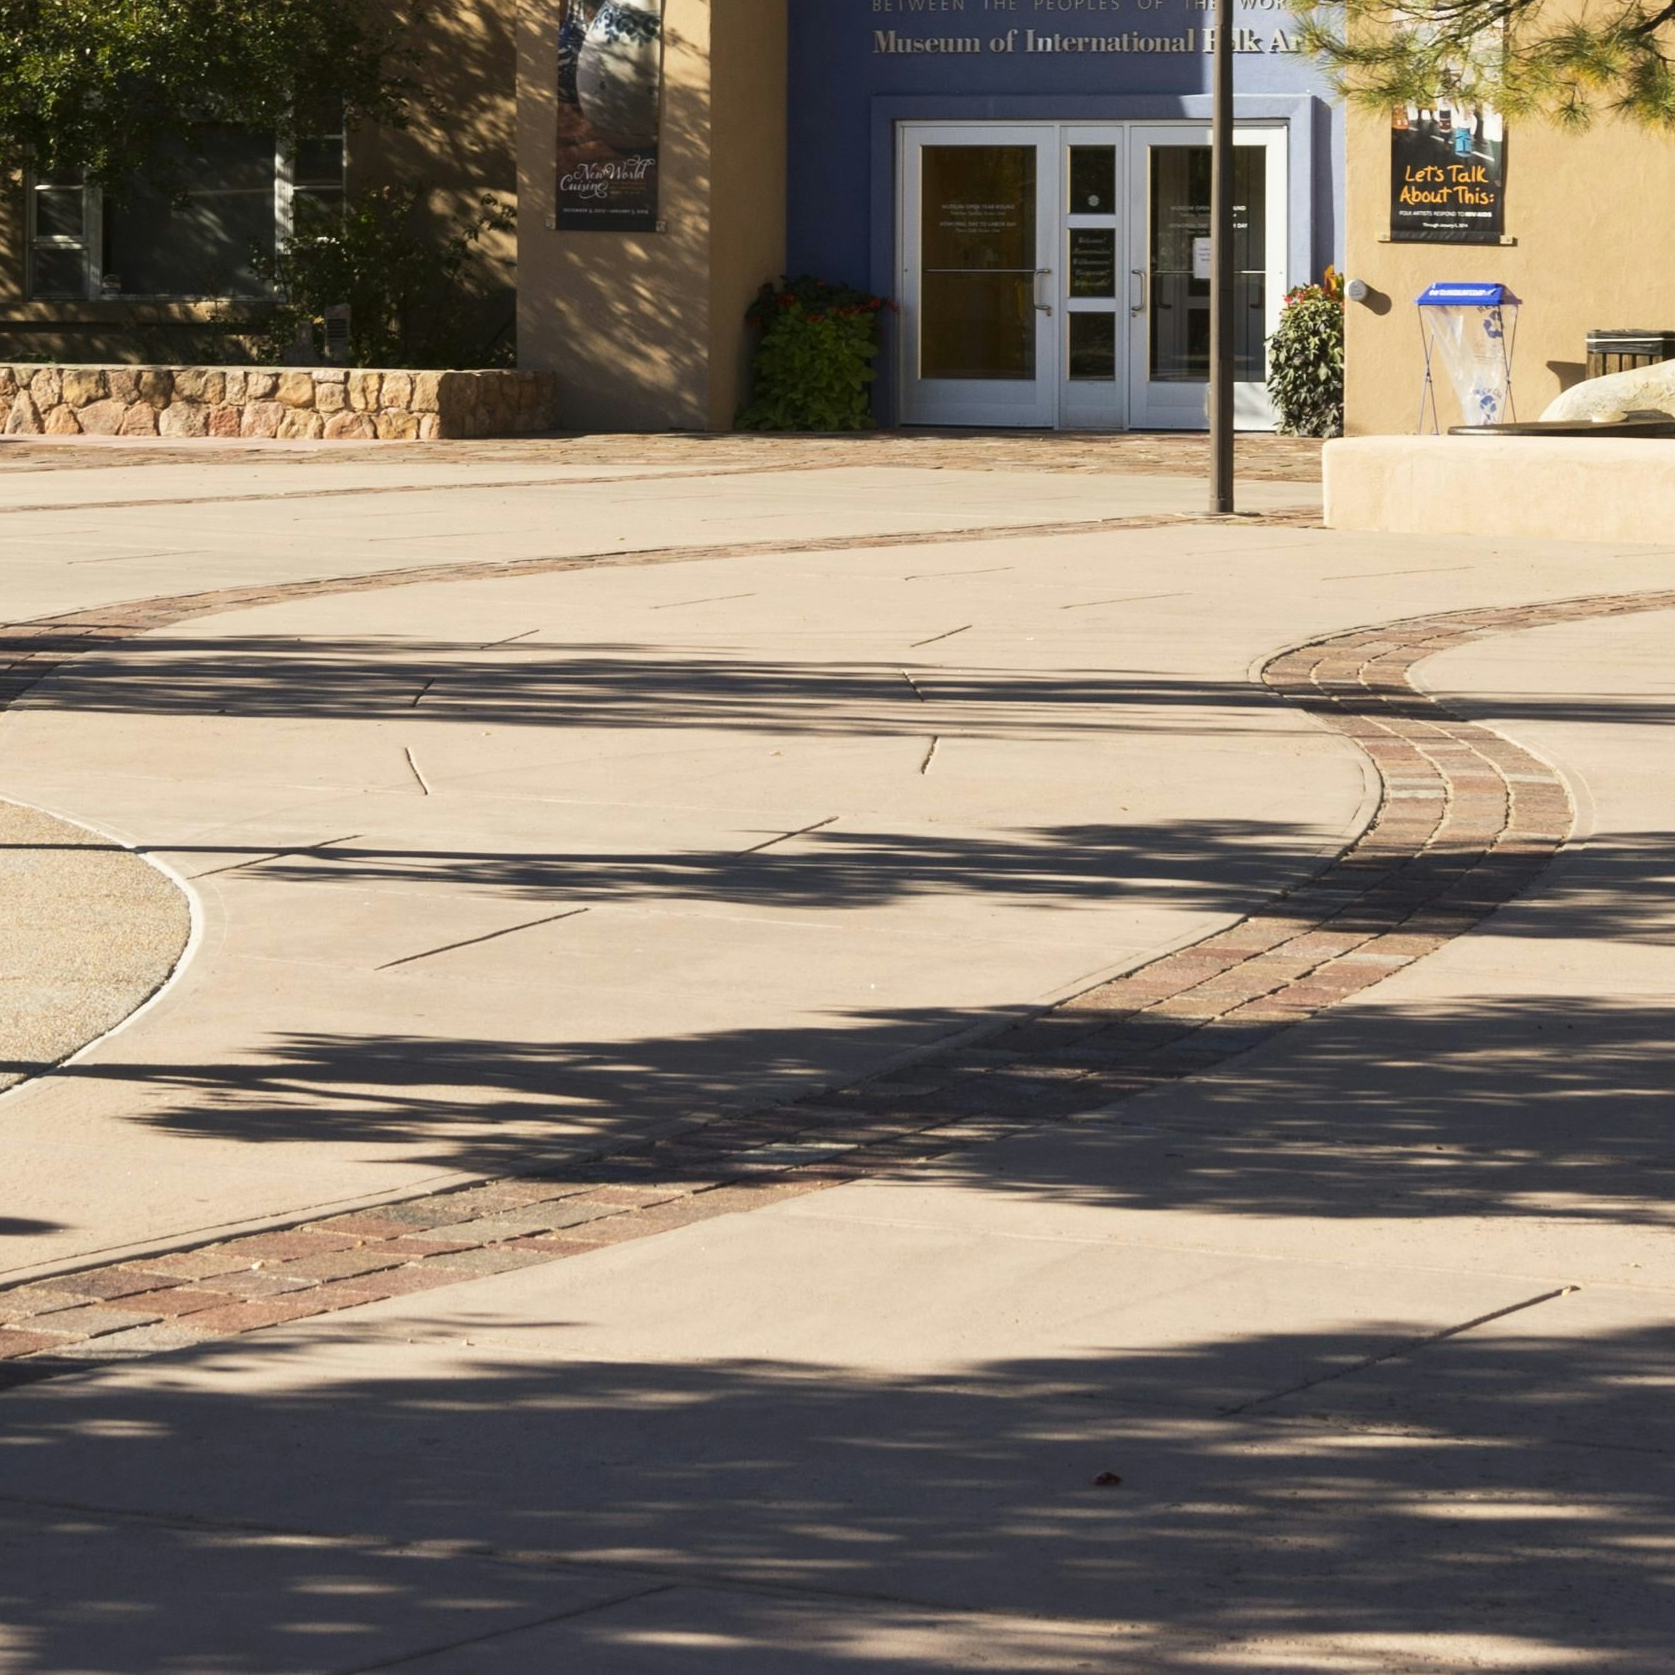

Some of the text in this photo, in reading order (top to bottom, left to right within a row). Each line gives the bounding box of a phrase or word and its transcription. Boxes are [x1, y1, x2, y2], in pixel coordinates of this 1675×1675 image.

[873, 28, 1303, 53] Museum of International Flk Ar
[574, 154, 656, 180] New World
[1405, 164, 1489, 183] Let's Talk
[560, 174, 609, 199] Cuisine
[1400, 185, 1495, 205] About This:
